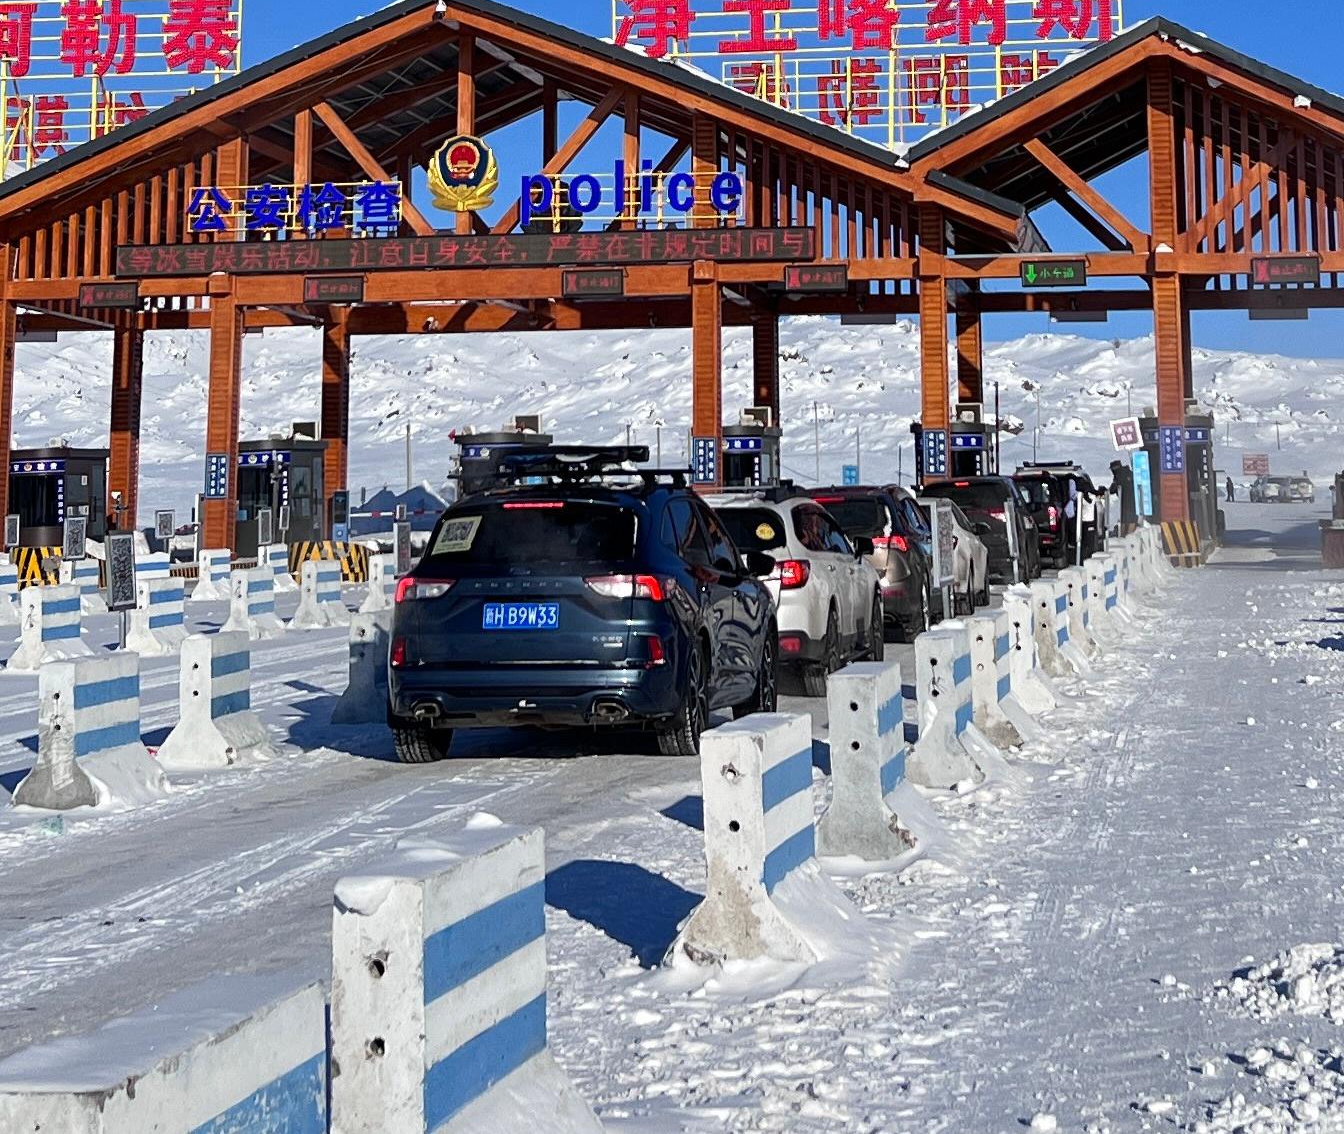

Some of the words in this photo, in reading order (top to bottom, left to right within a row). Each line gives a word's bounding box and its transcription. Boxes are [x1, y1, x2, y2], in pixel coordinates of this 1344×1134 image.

[186, 180, 401, 231] 公安检查
[520, 159, 743, 226] police
